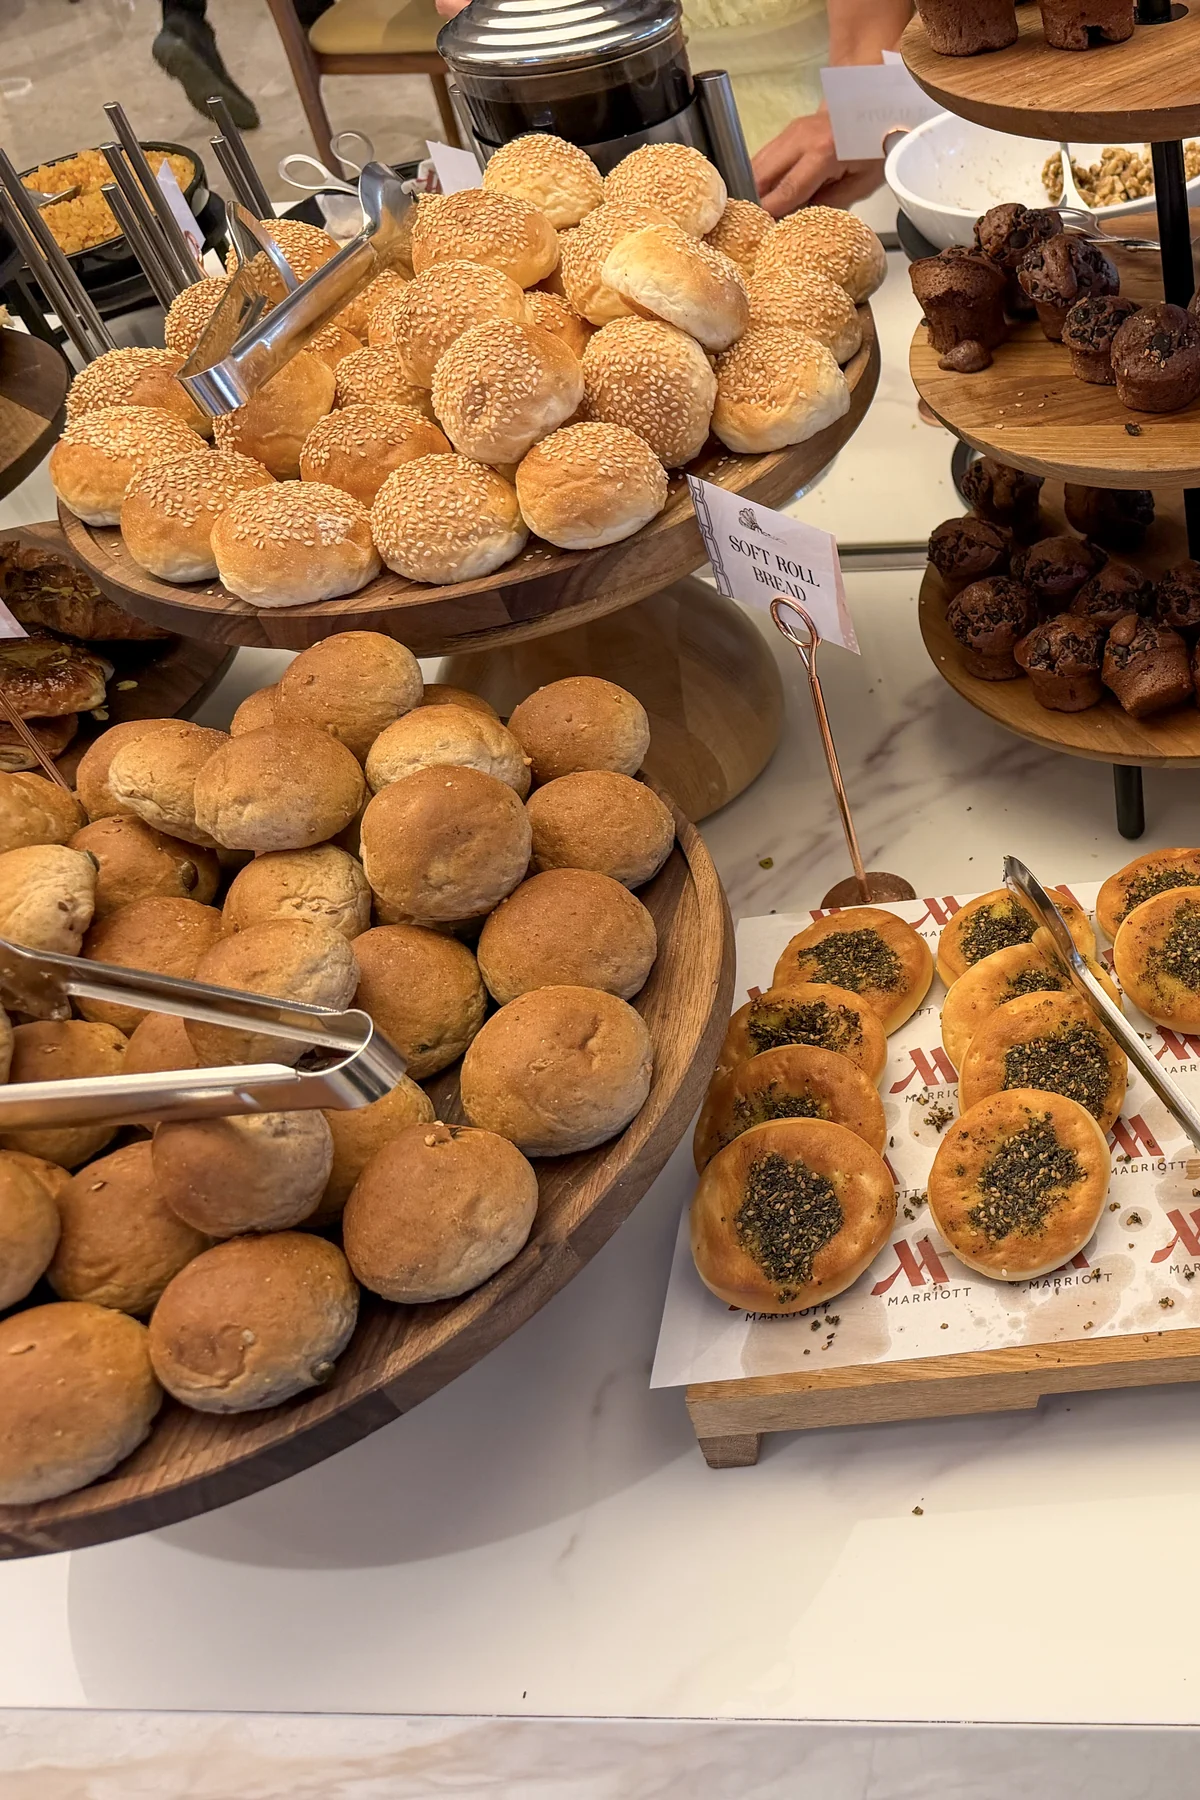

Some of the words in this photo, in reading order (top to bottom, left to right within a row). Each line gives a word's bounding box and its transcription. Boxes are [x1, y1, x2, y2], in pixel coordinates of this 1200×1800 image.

[728, 535, 771, 565] SOFT
[776, 555, 821, 588] ROLL
[752, 566, 807, 602] BREAD
[887, 1287, 972, 1307] MARRIOTT
